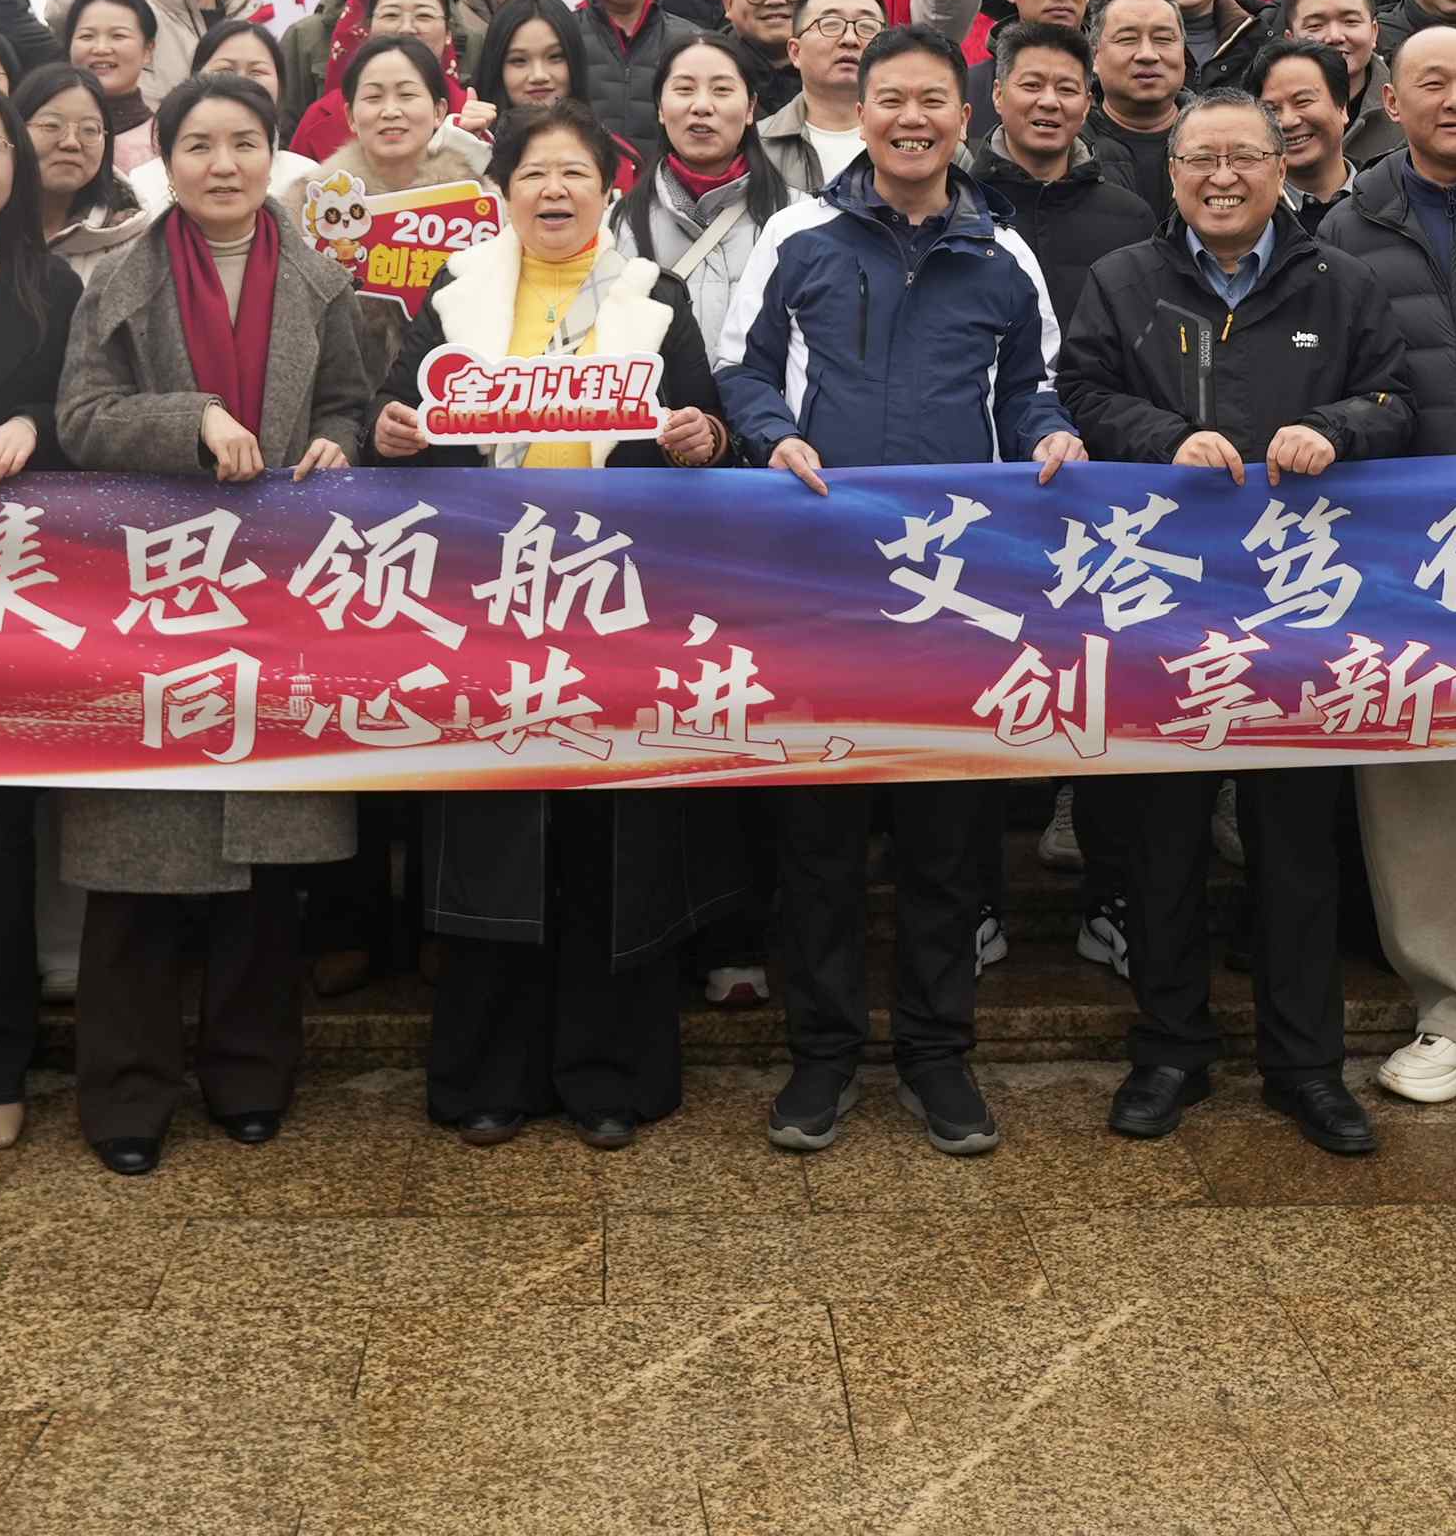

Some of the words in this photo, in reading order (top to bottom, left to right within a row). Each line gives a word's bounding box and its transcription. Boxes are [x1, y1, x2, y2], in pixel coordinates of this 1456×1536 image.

[391, 211, 498, 250] 2026
[1292, 331, 1319, 343] Jeep
[430, 410, 489, 428] GIVE
[527, 407, 597, 426] YOUR
